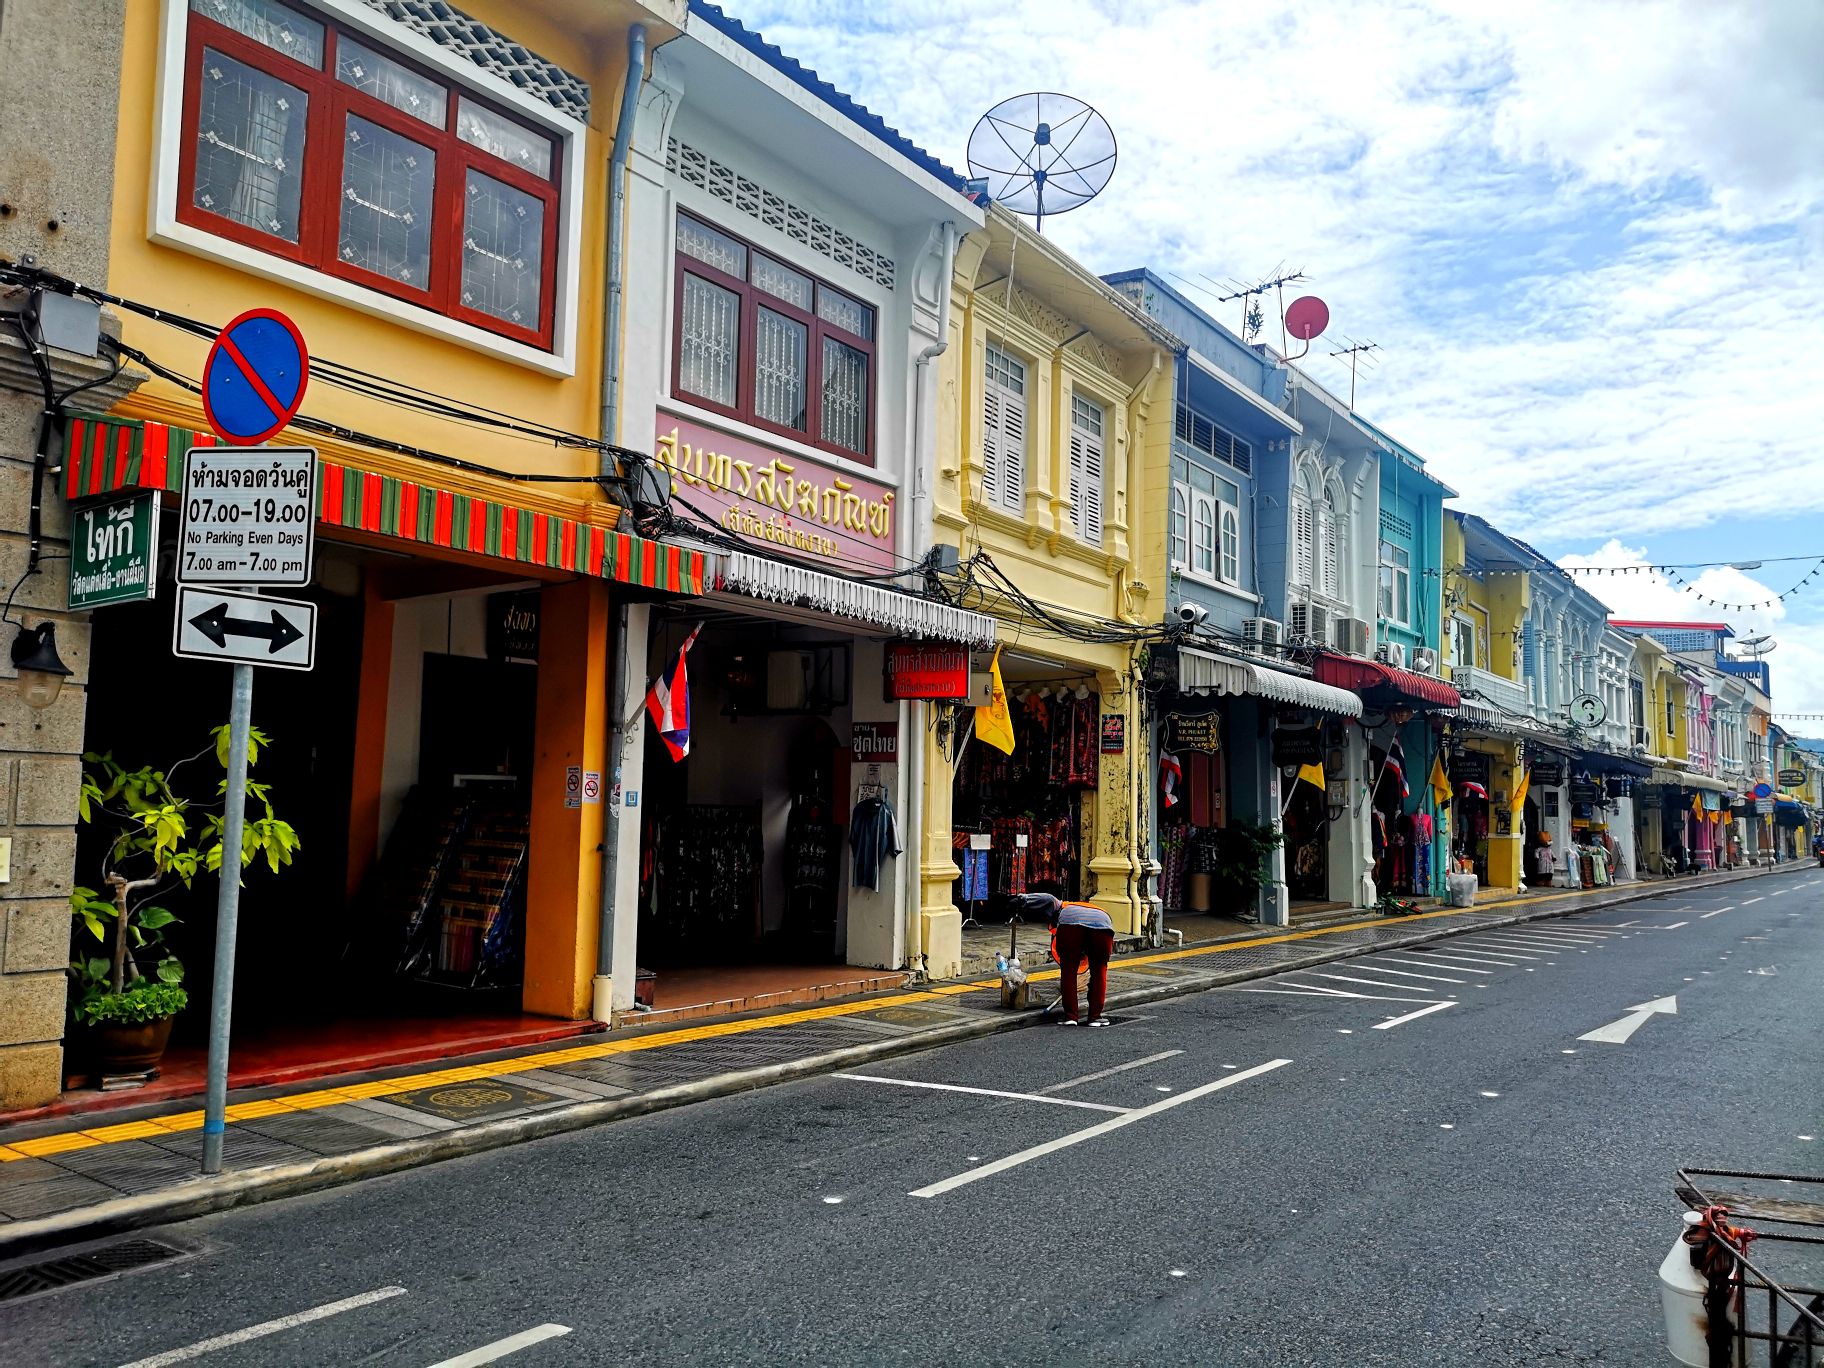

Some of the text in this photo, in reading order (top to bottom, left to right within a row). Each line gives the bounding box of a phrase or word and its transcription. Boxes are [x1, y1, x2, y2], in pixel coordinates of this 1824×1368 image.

[192, 462, 309, 498] ห้ามจอดวันคู่
[187, 531, 304, 547] No Parking Even Days
[186, 552, 212, 571] 7.00
[281, 560, 303, 574] pm
[853, 726, 896, 760] ชุดไทย
